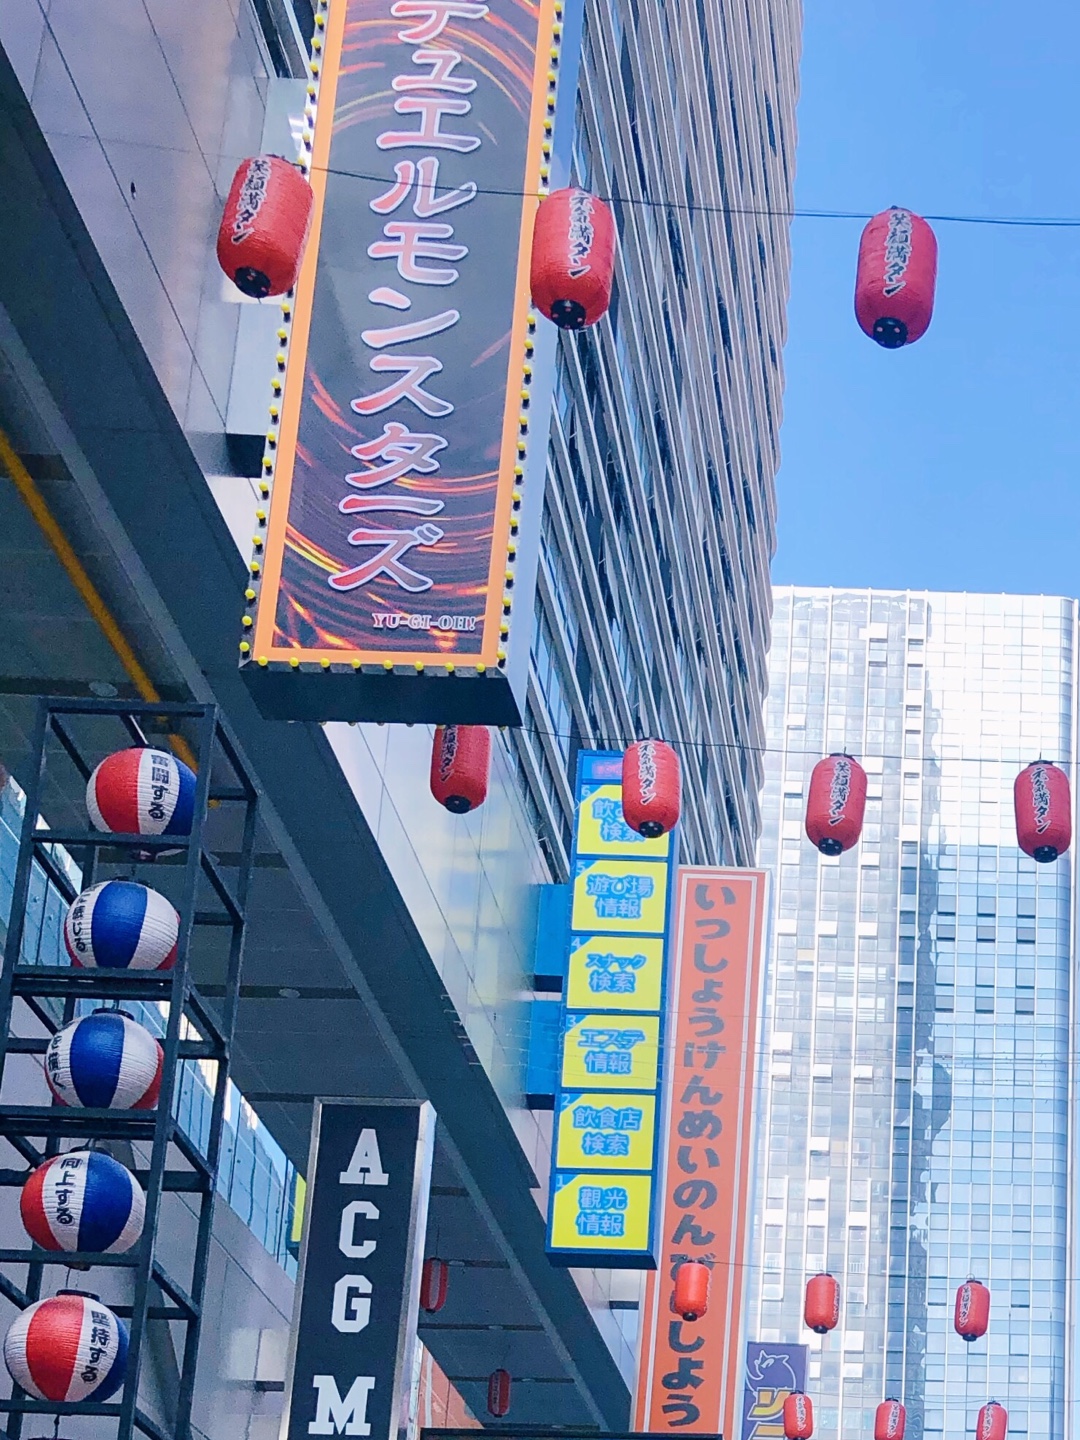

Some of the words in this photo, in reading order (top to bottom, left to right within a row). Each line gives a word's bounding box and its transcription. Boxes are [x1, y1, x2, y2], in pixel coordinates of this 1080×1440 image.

[587, 875, 653, 897] 遊び場
[594, 896, 642, 919] 情報
[586, 953, 646, 970] スナック
[589, 969, 635, 993] 検索
[578, 1028, 646, 1050] エステ
[584, 1051, 631, 1074] 情報
[573, 1107, 641, 1131] 飲食店
[582, 1131, 629, 1156] 検索
[330, 1127, 390, 1333] ACG
[576, 1213, 626, 1237] 情報
